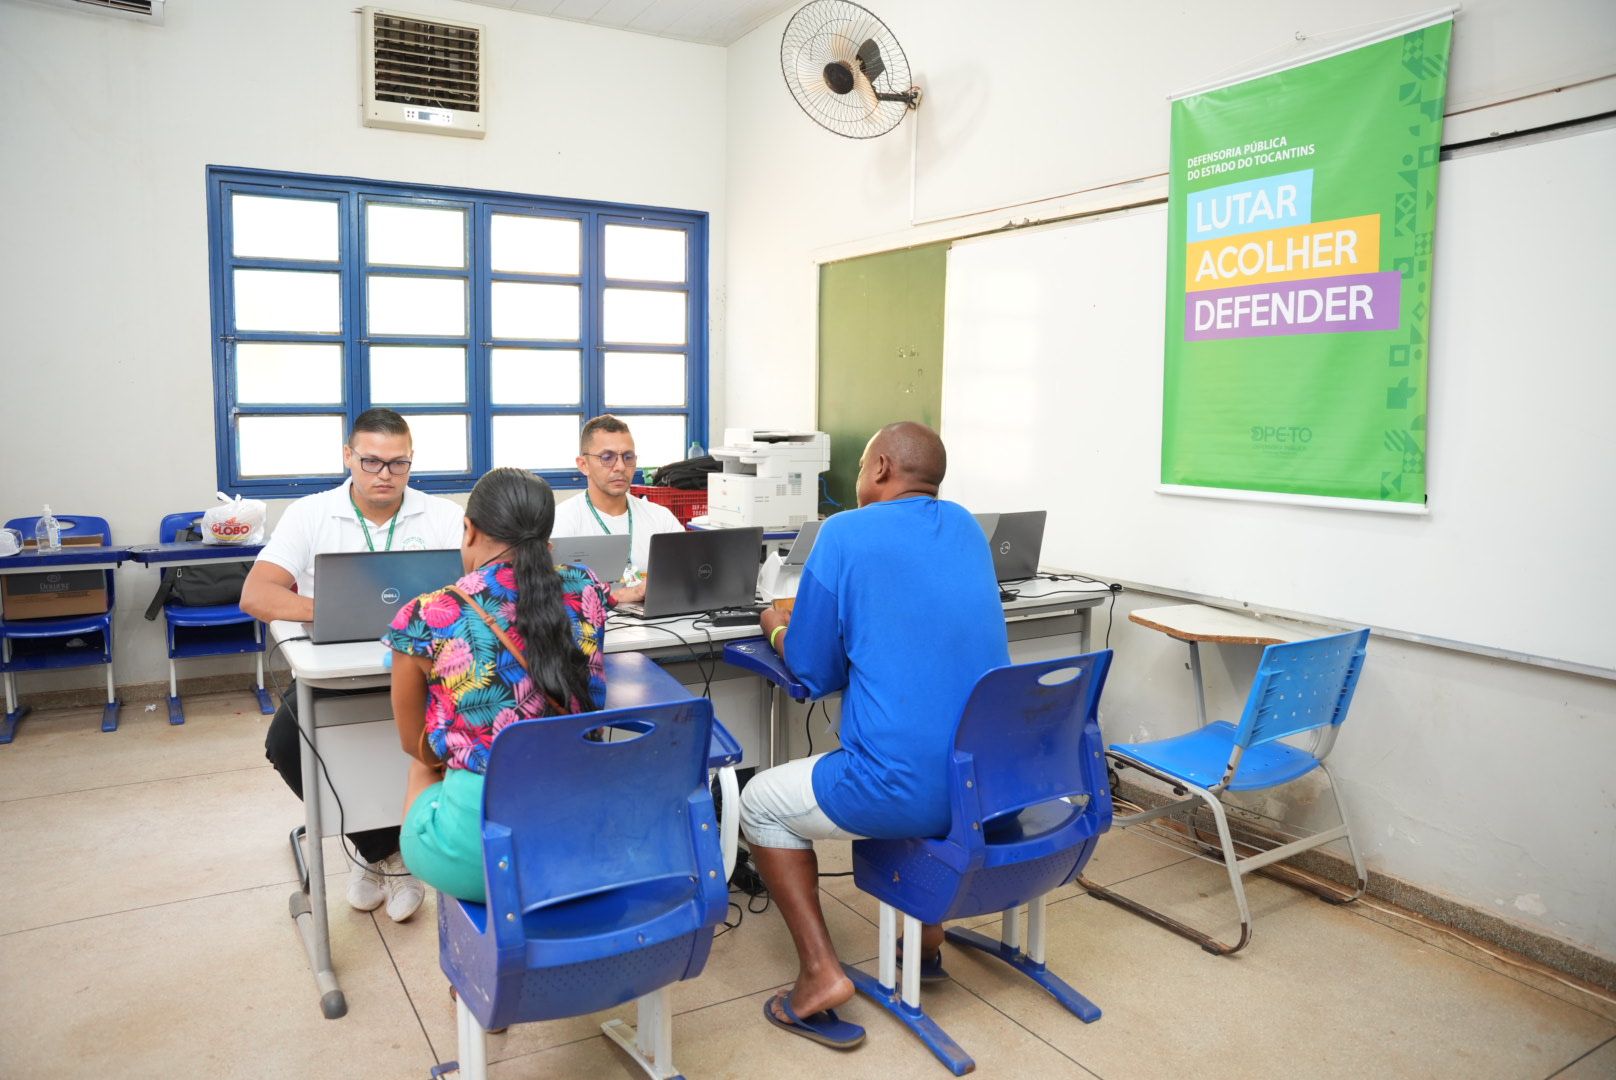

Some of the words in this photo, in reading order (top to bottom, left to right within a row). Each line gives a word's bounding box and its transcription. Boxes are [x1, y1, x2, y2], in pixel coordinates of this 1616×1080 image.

[1187, 147, 1242, 168] DEFENSORIA
[1243, 136, 1287, 155] PÚBLICA
[1187, 170, 1200, 181] DO
[1201, 161, 1236, 177] ESTADO
[1237, 158, 1252, 169] DO
[1254, 144, 1315, 165] TOCANTINS
[1196, 184, 1297, 233] LUTAR
[1194, 229, 1358, 282] ACOLHER
[1194, 284, 1374, 332] DEFENDER
[211, 523, 250, 536] GLOBO
